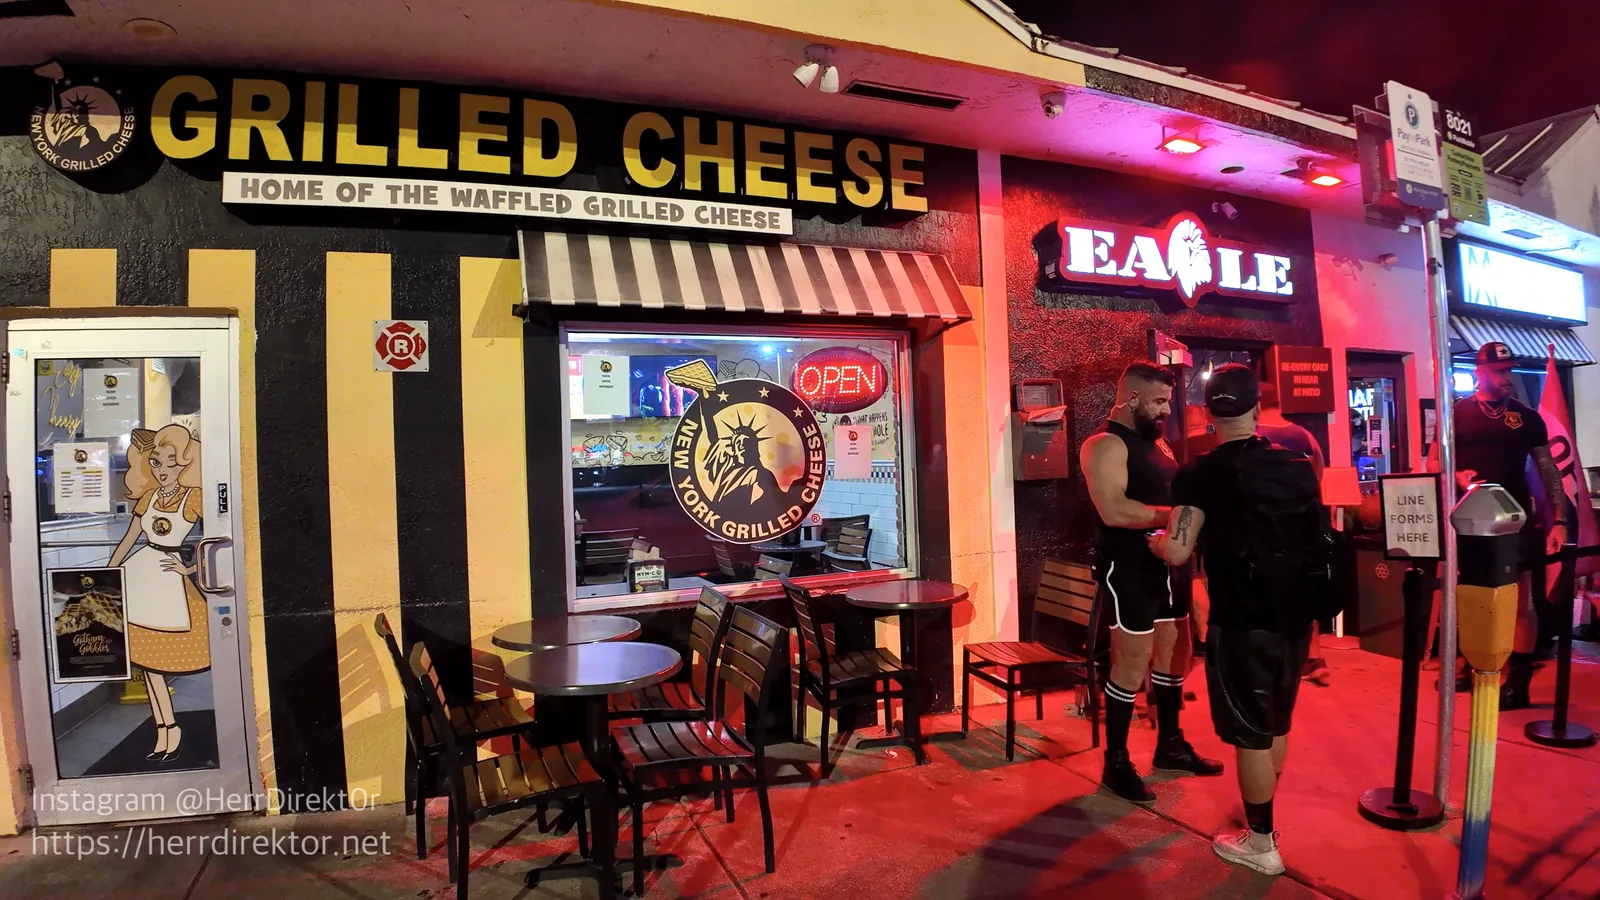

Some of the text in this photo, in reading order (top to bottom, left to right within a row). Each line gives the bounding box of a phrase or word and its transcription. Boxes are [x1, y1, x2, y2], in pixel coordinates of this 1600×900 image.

[1446, 113, 1472, 136] 8021
[34, 133, 60, 165] YORK
[60, 151, 114, 171] GRILLED
[112, 106, 135, 154] CHEESE
[150, 74, 929, 213] GRILLED CHEESE
[240, 177, 781, 230] HOME OF THE WAFFLED GRILLED CHEESE
[394, 339, 409, 354] R
[1281, 362, 1329, 372] RE-ENTRY ONLY
[1293, 375, 1301, 384] IN
[800, 365, 876, 396] OPEN
[1293, 388, 1321, 397] AT PATIO
[869, 412, 888, 422] HAPPENS
[674, 418, 699, 470] NEW
[801, 423, 823, 504] CHEESE
[219, 485, 227, 512] PULL
[677, 475, 721, 529] YORK
[1397, 495, 1425, 505] LINE
[721, 505, 803, 539] GRILLED
[1390, 514, 1434, 524] FORMS
[1396, 533, 1429, 542] HERE
